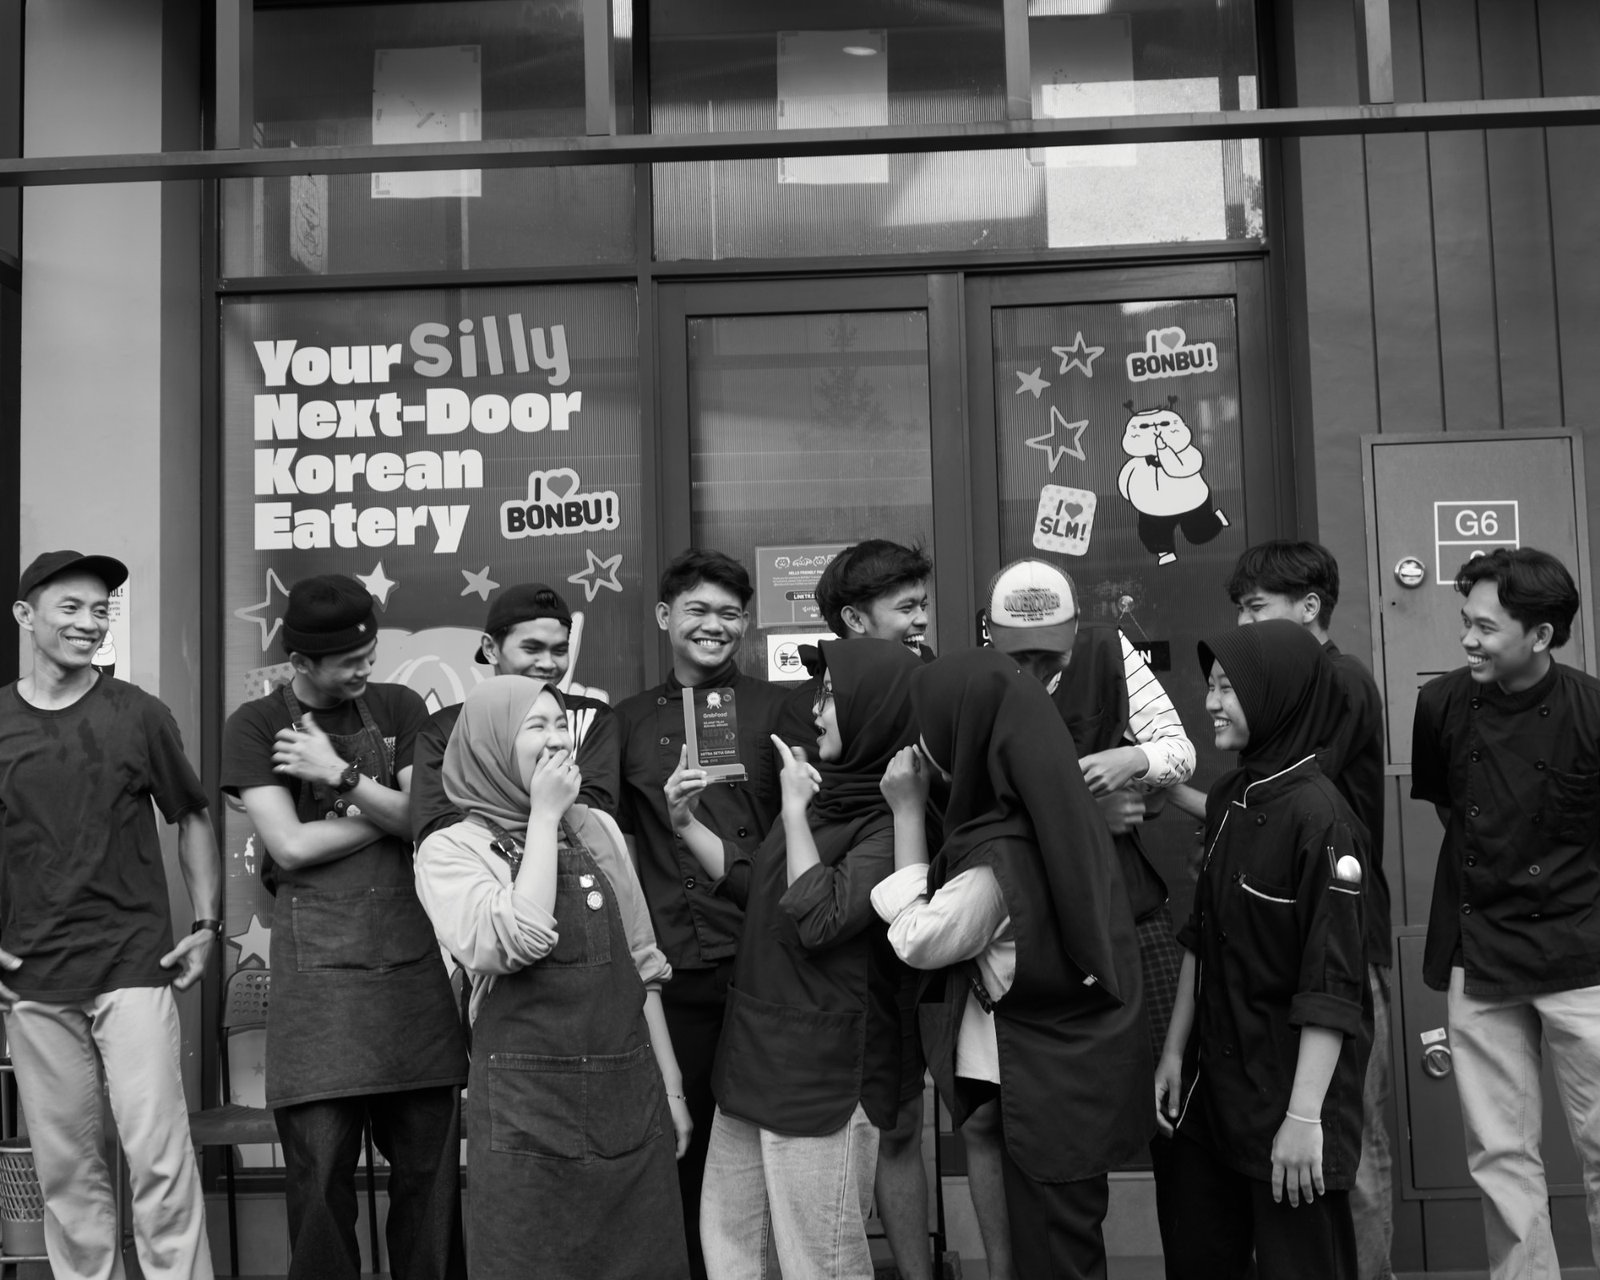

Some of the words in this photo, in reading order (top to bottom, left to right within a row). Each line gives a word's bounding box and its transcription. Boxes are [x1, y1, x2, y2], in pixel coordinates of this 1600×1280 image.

[253, 338, 402, 387] Your
[409, 313, 571, 386] Silly
[1151, 335, 1157, 353] I
[1131, 348, 1214, 377] BONBU!
[254, 388, 582, 441] Next-Door
[254, 447, 483, 495] Korean
[534, 476, 542, 502] I
[506, 497, 614, 533] BONBU!
[1055, 499, 1064, 516] I
[254, 502, 471, 554] Eatery
[1039, 516, 1087, 542] SLM!
[1455, 509, 1498, 536] G6
